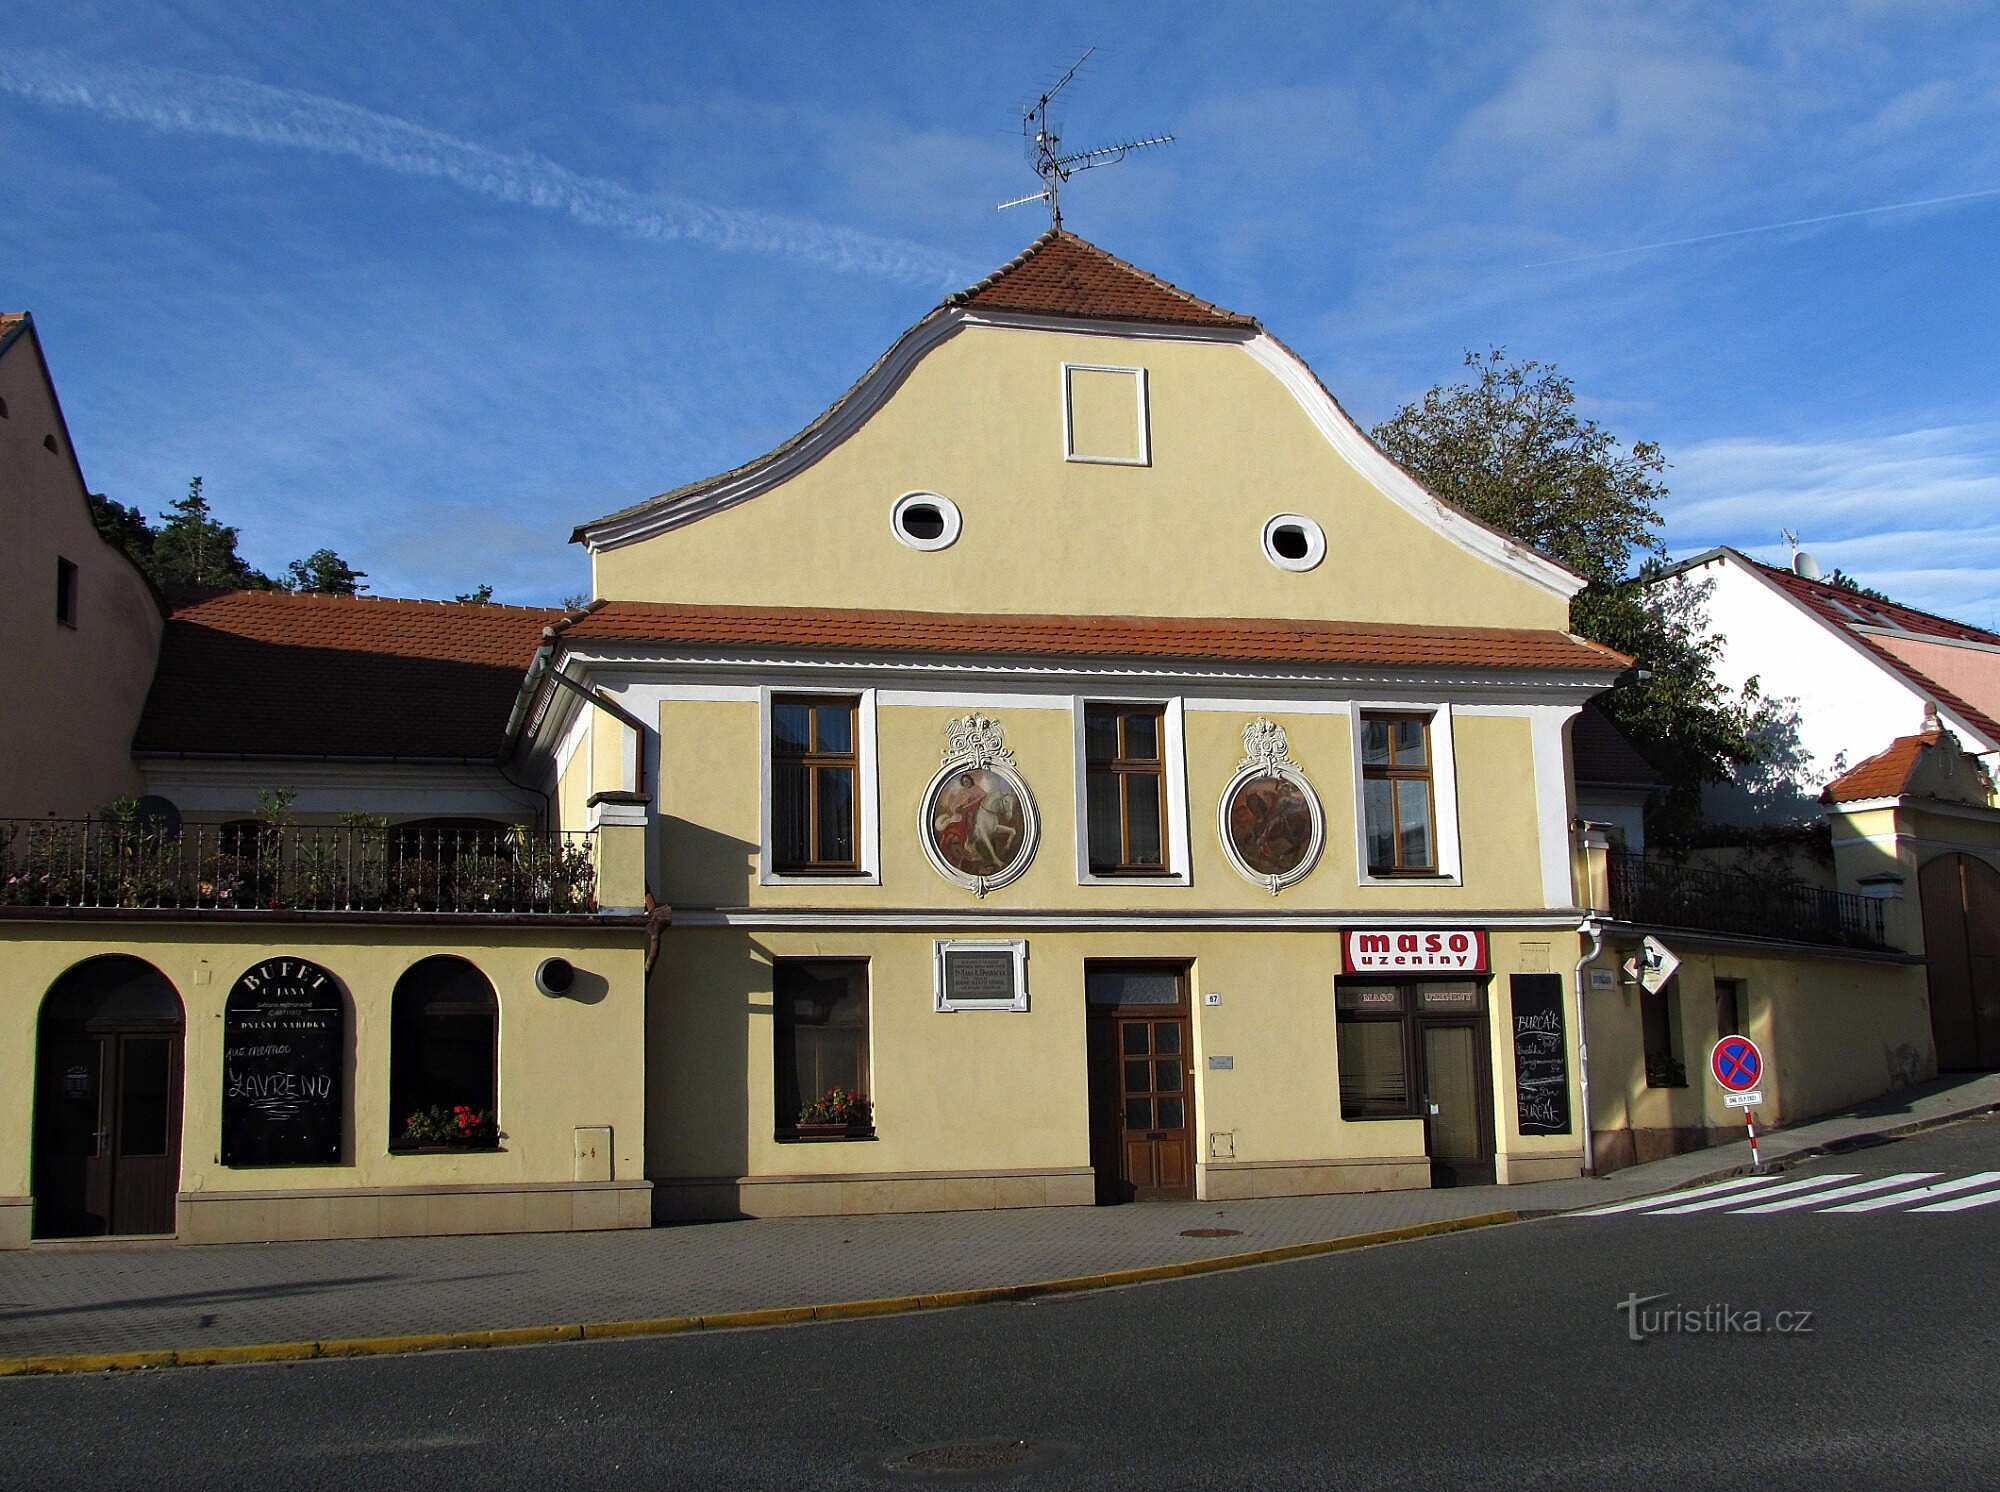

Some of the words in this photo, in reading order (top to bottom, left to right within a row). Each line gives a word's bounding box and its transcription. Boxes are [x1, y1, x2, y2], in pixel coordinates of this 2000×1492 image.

[1359, 934, 1469, 953] maso
[1361, 953, 1468, 967] uzeniny
[243, 962, 328, 991] BUFET
